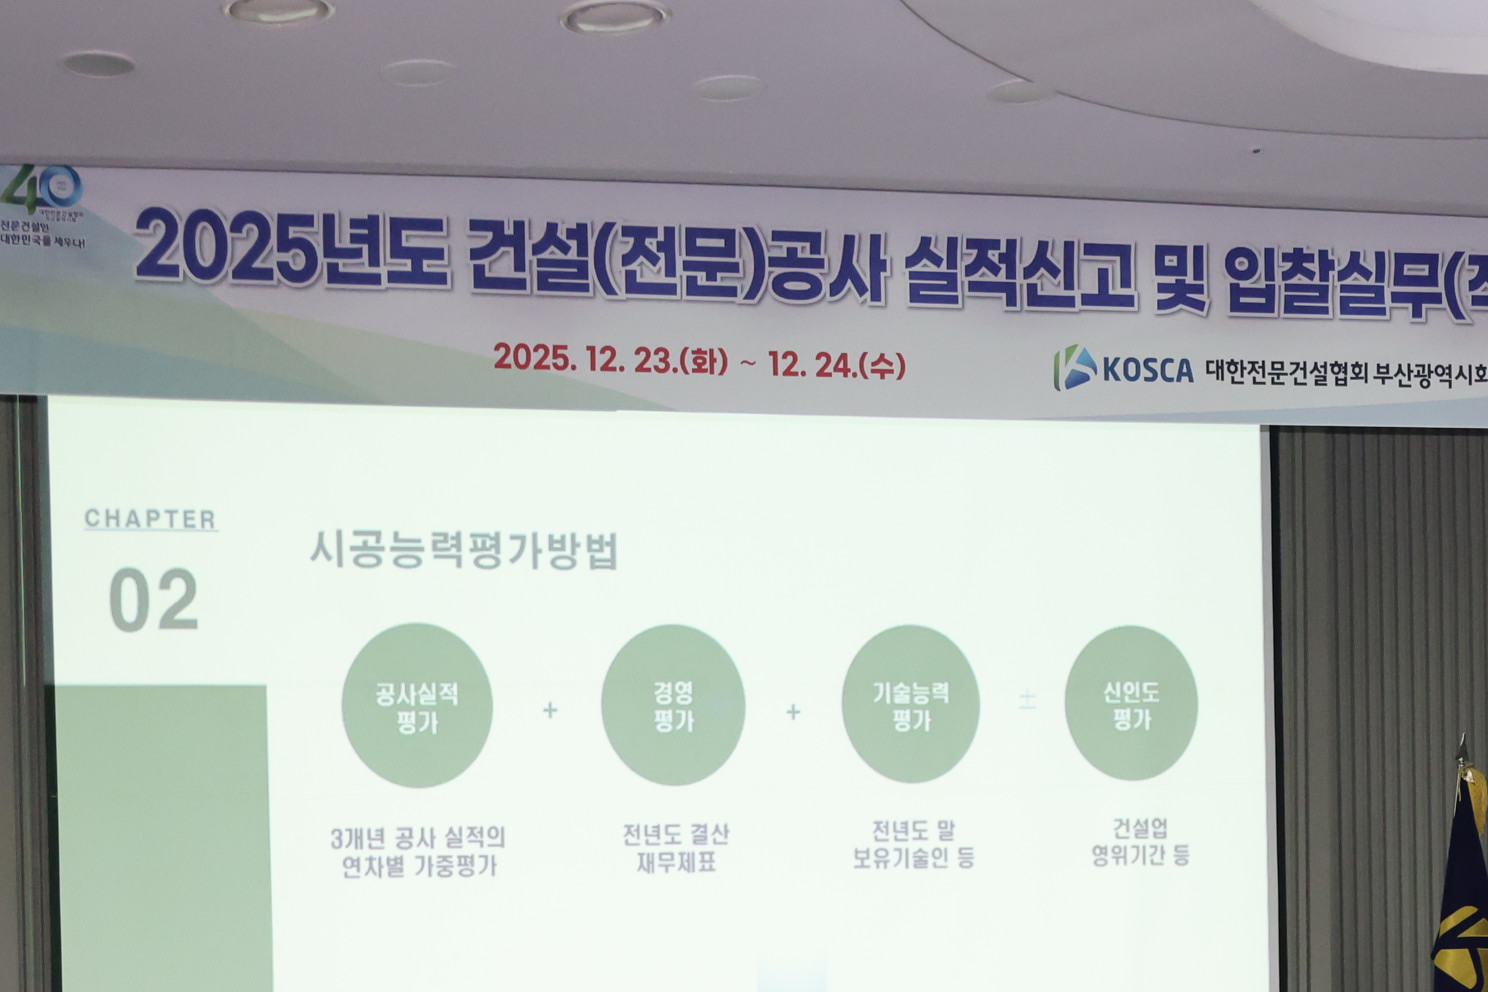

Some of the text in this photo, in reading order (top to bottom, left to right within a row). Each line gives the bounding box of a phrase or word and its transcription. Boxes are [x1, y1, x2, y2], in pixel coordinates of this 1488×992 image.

[136, 206, 448, 286] 2025년도
[469, 218, 887, 302] 건설(전문)공사
[905, 236, 1135, 308] 실적신고
[1154, 244, 1206, 312] 및
[495, 342, 578, 371] 2025.
[586, 345, 626, 372] 12.
[635, 346, 729, 376] 23.(화)
[769, 350, 807, 377] 12.
[816, 351, 907, 380] 24.(수)
[1103, 356, 1195, 383] KOSCA
[1205, 358, 1368, 387] 대한전문건설협회
[84, 508, 215, 529] CHAPTER
[310, 529, 617, 571] 시공능력평가방법
[109, 567, 198, 633] 02
[376, 682, 458, 707] 공사실적
[654, 680, 693, 705] 경영
[873, 681, 949, 705] 기술능력
[1103, 681, 1160, 704] 신인도
[397, 710, 439, 735] 평가
[654, 709, 695, 733] 평가
[893, 708, 932, 733] 평가
[1113, 707, 1152, 731] 평가
[331, 825, 505, 851] 3개년 공사 실적의
[623, 823, 730, 847] 전년도 결산
[872, 820, 956, 843] 전년도 말
[1114, 817, 1168, 840] 건설업
[342, 853, 498, 879] 연차별 가중평가
[637, 850, 716, 874] 재무제표
[854, 846, 975, 870] 보유기술인 등
[1091, 844, 1190, 868] 영위기간 등
